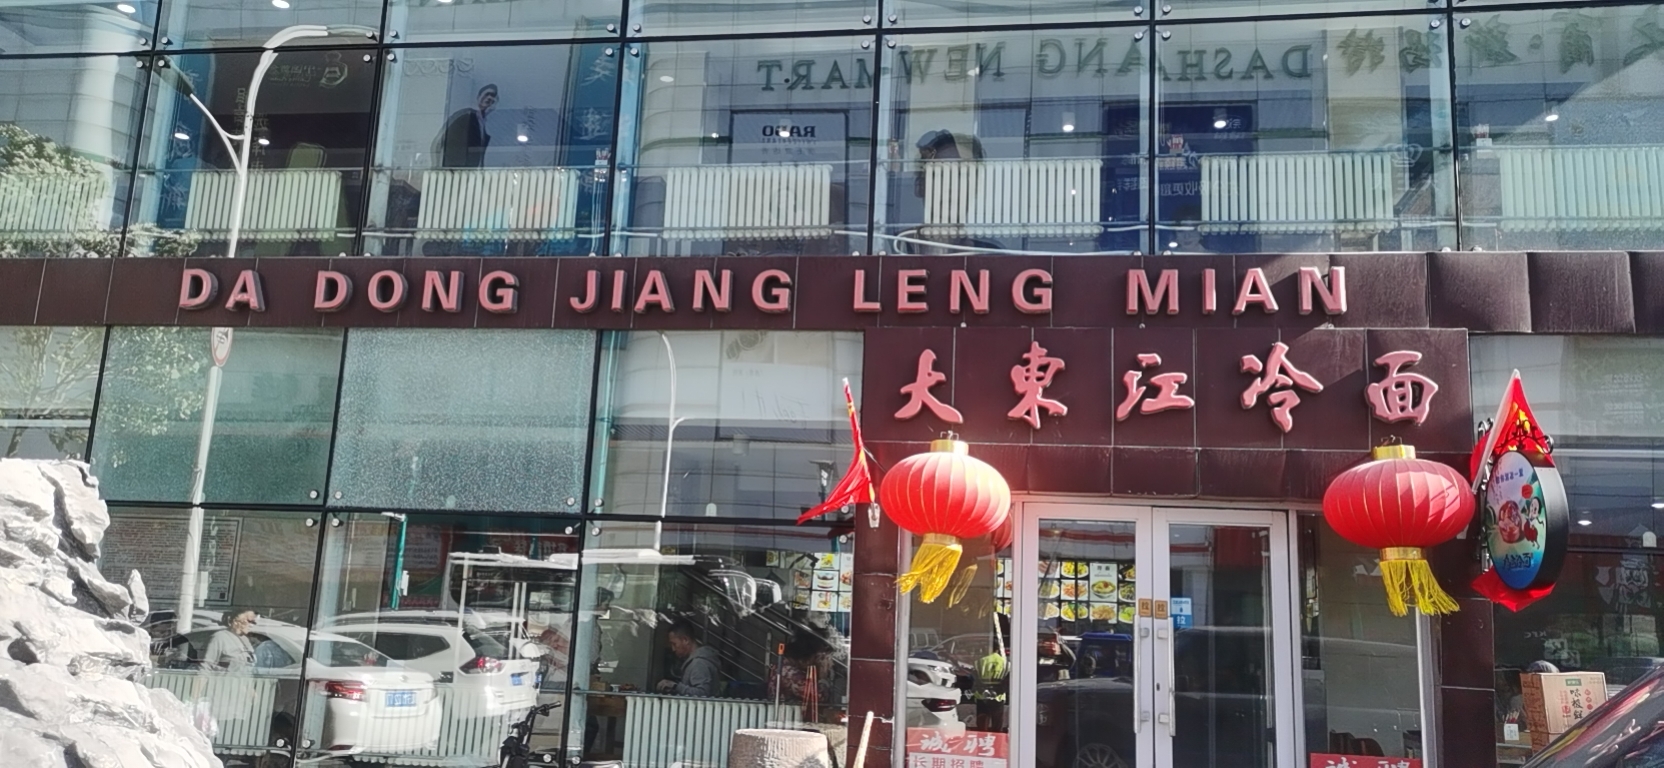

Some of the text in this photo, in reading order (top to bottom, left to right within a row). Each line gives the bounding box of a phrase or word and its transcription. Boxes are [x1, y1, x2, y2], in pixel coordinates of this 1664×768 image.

[178, 265, 1348, 316] DA DONG JIANG LENG MIAN
